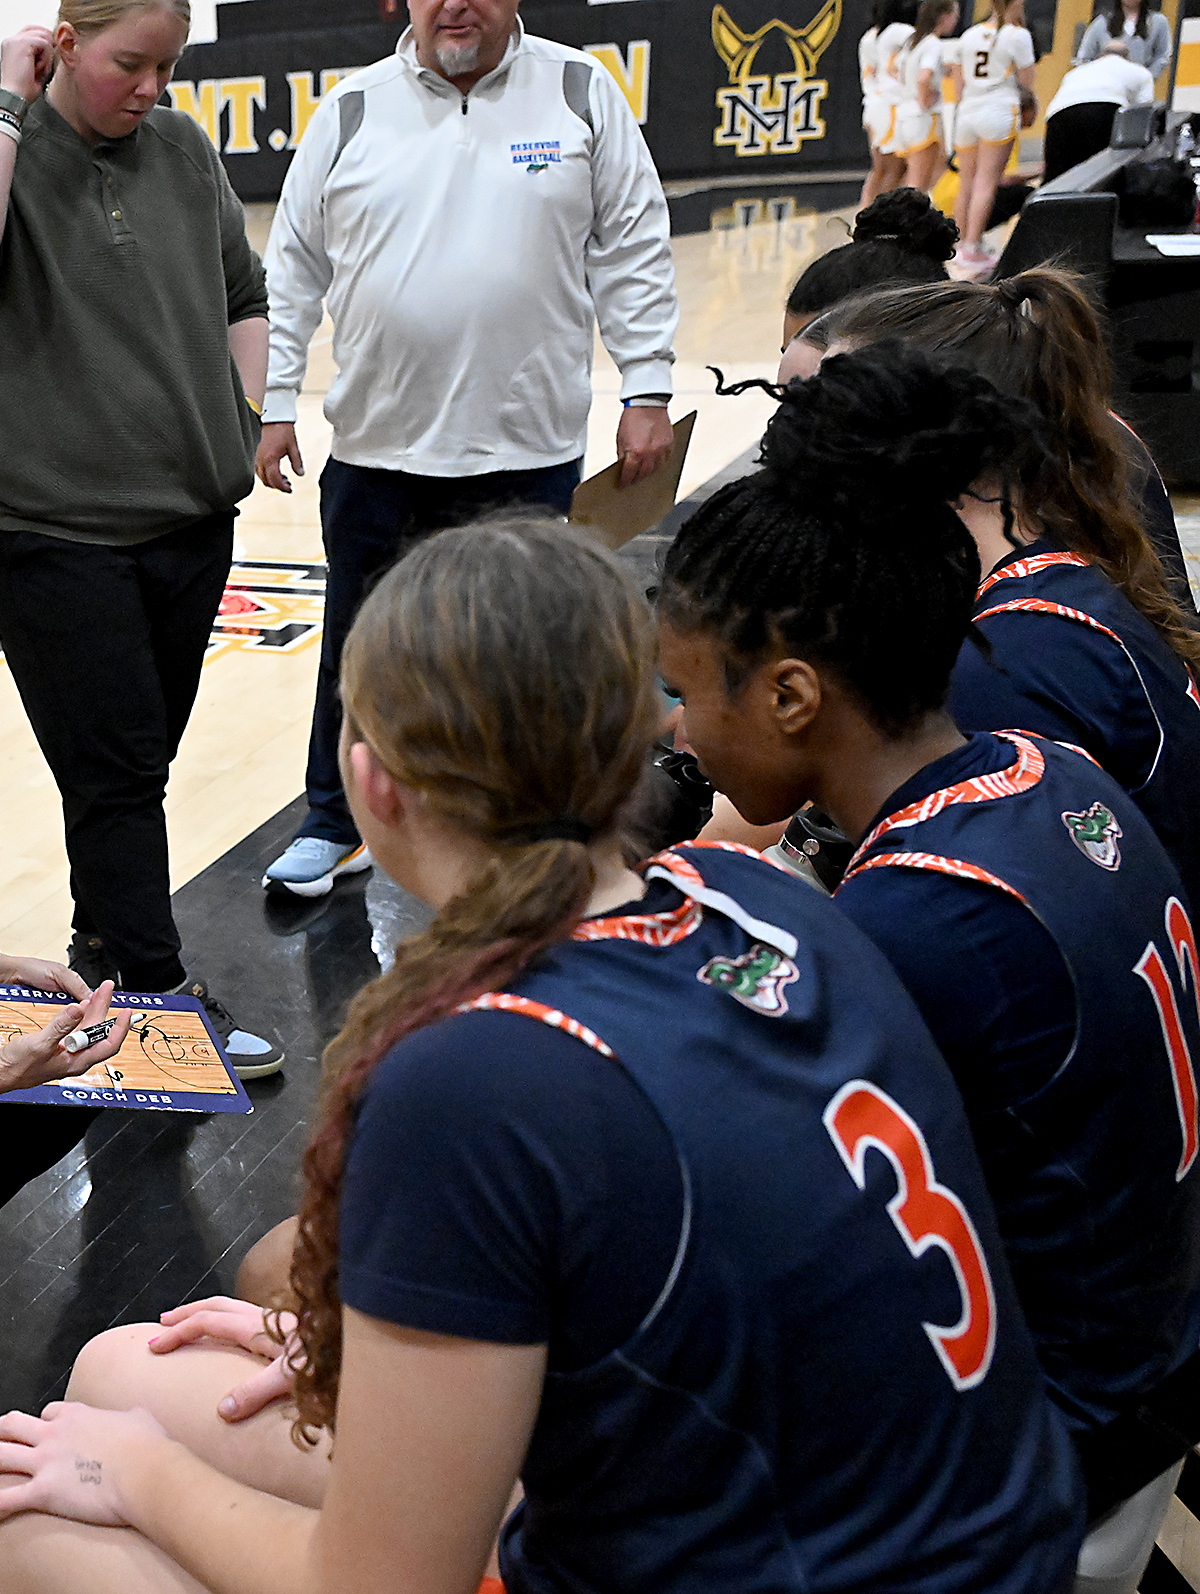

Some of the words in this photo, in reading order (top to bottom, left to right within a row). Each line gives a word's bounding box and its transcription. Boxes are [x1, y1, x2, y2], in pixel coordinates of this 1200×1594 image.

[974, 51, 989, 77] 2
[110, 995, 164, 1006] ATORS
[61, 1089, 128, 1103] COACH
[136, 1093, 173, 1104] DEB
[822, 1078, 998, 1392] 3
